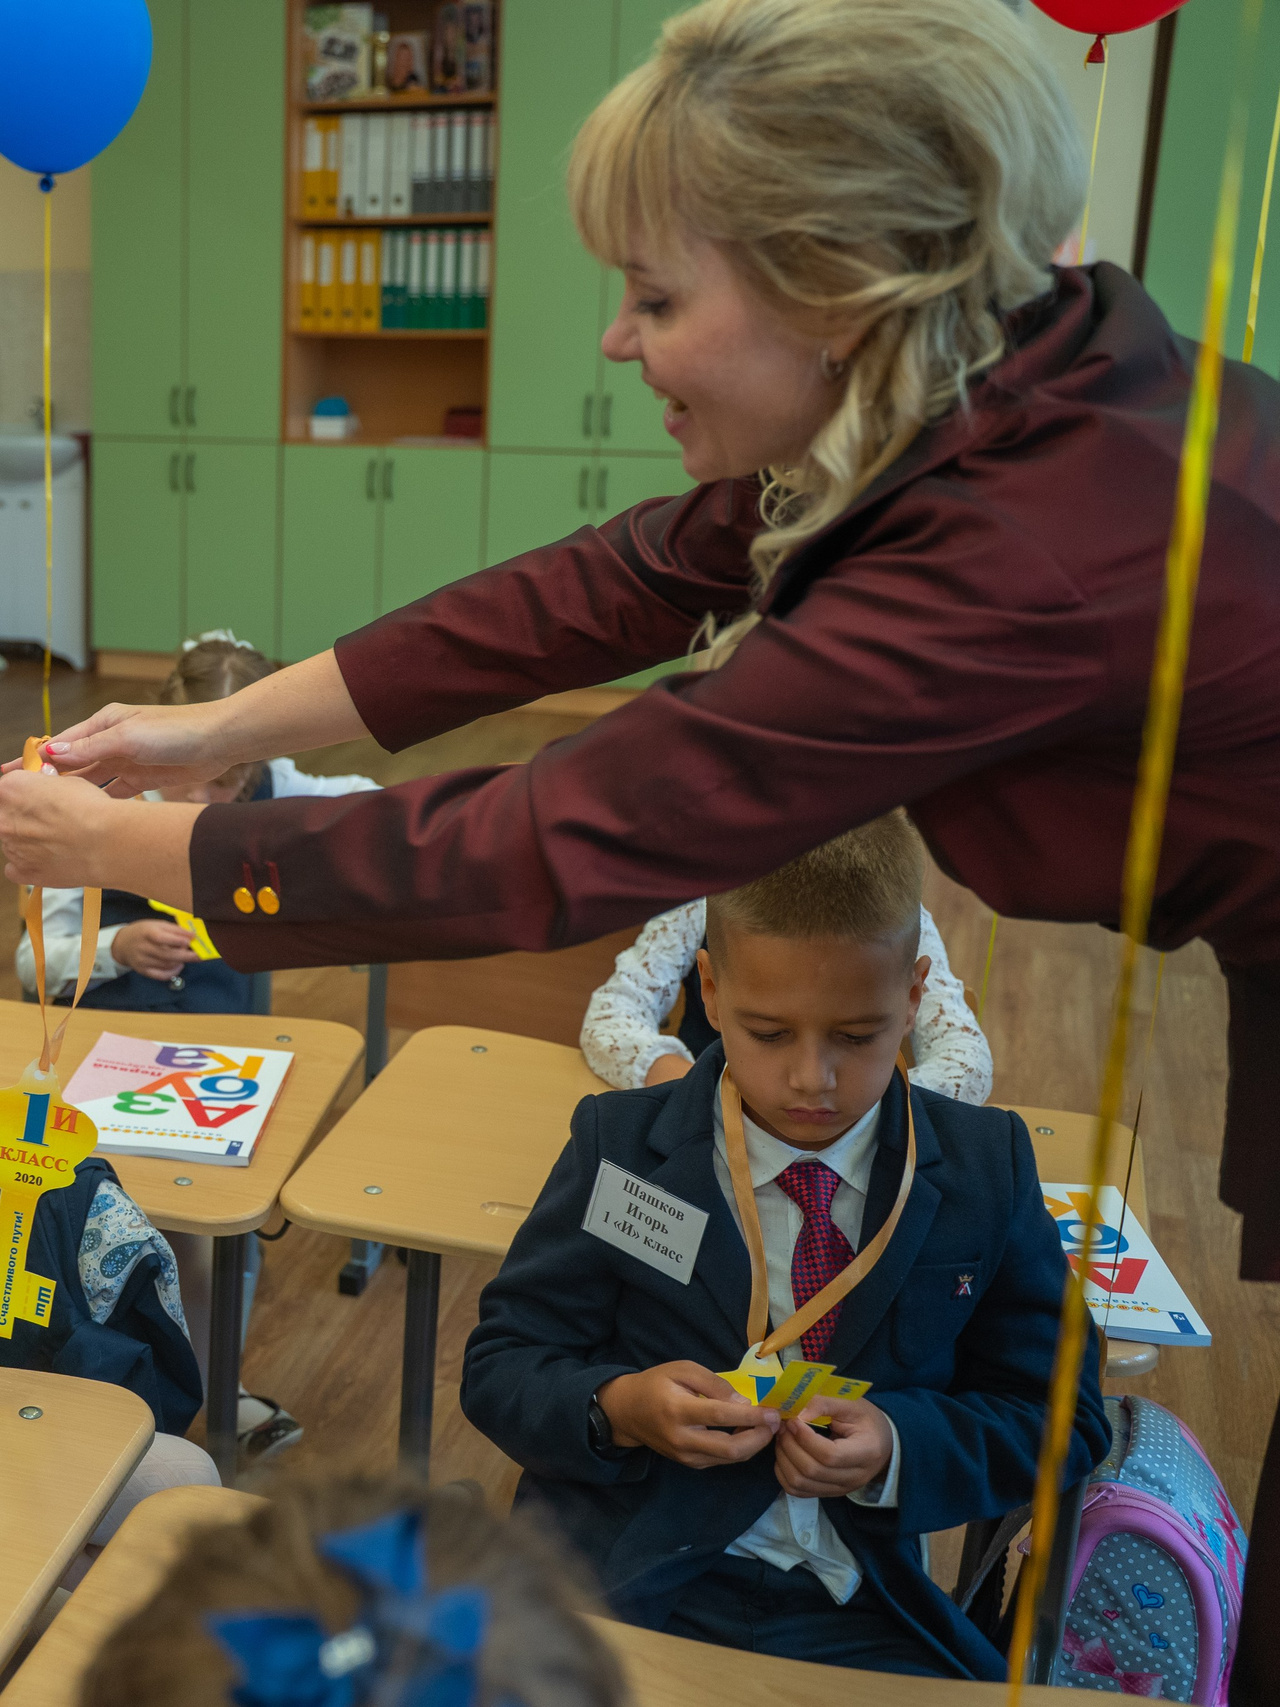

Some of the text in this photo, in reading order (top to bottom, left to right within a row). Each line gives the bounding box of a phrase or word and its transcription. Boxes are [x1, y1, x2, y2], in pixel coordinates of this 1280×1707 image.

[16, 1091, 81, 1147] 1 И
[14, 1171, 43, 1187] 2020
[622, 1179, 685, 1222] Шашков
[626, 1202, 669, 1235] Игорь
[12, 1210, 24, 1244] пути!
[602, 1211, 683, 1264] 1 «И» класс
